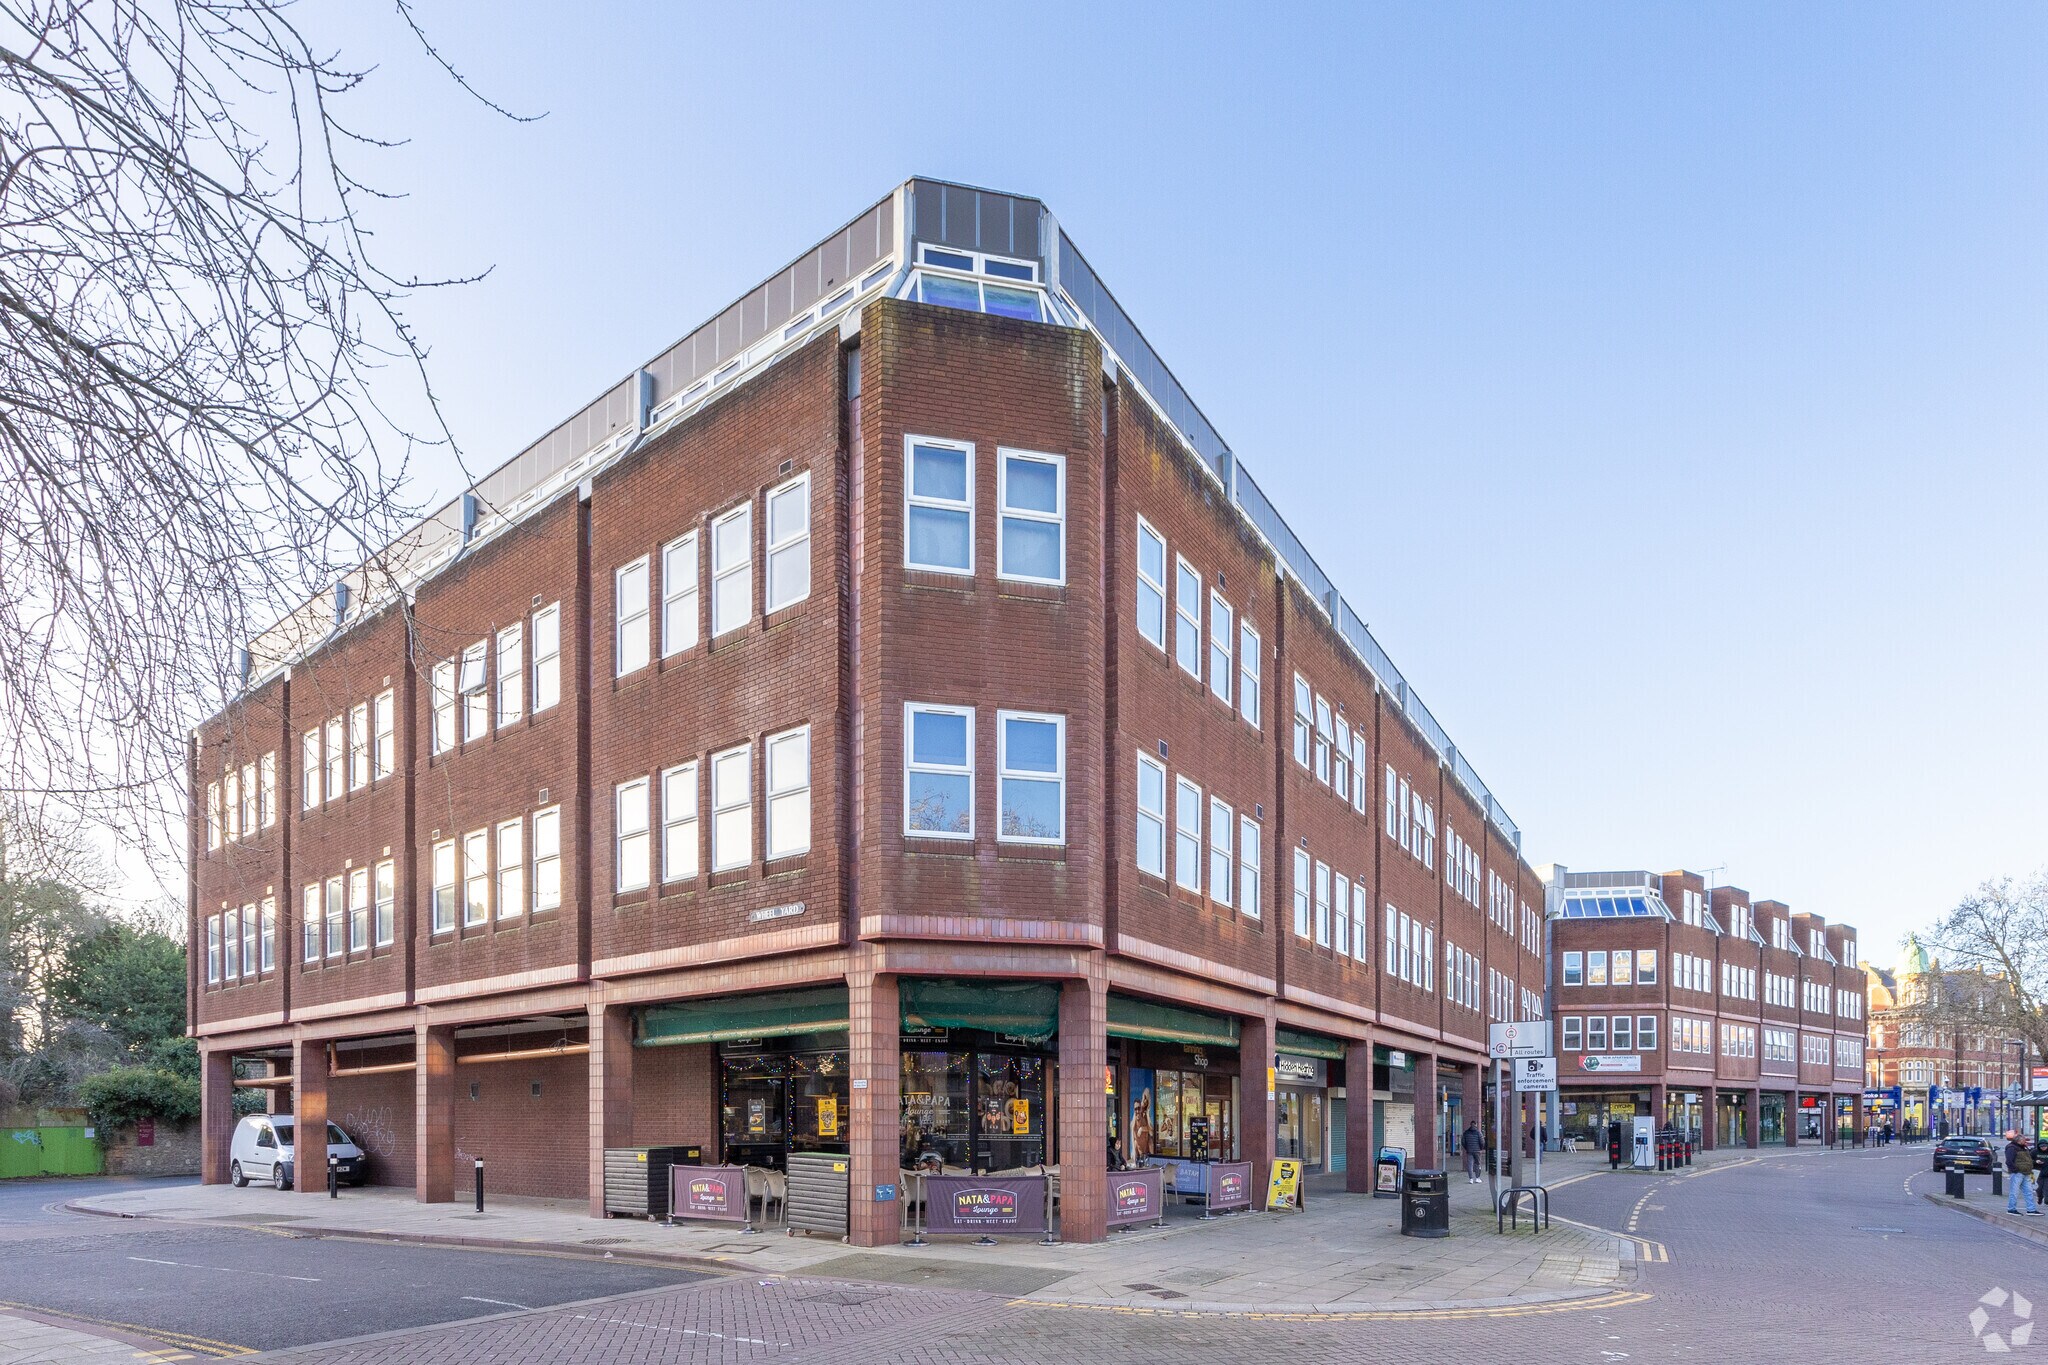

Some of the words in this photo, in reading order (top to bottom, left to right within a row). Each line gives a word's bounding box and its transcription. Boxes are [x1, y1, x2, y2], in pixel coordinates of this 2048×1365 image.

[780, 904, 799, 915] YARD
[1194, 1054, 1209, 1070] Shop
[1279, 1060, 1297, 1073] Hidden
[1297, 1062, 1315, 1077] Hearing
[899, 1094, 951, 1107] ATA&PAPA
[692, 1184, 723, 1194] NATA&PAPA
[958, 1193, 1014, 1206] NATA&PAPA
[973, 1205, 999, 1215] Lounge
